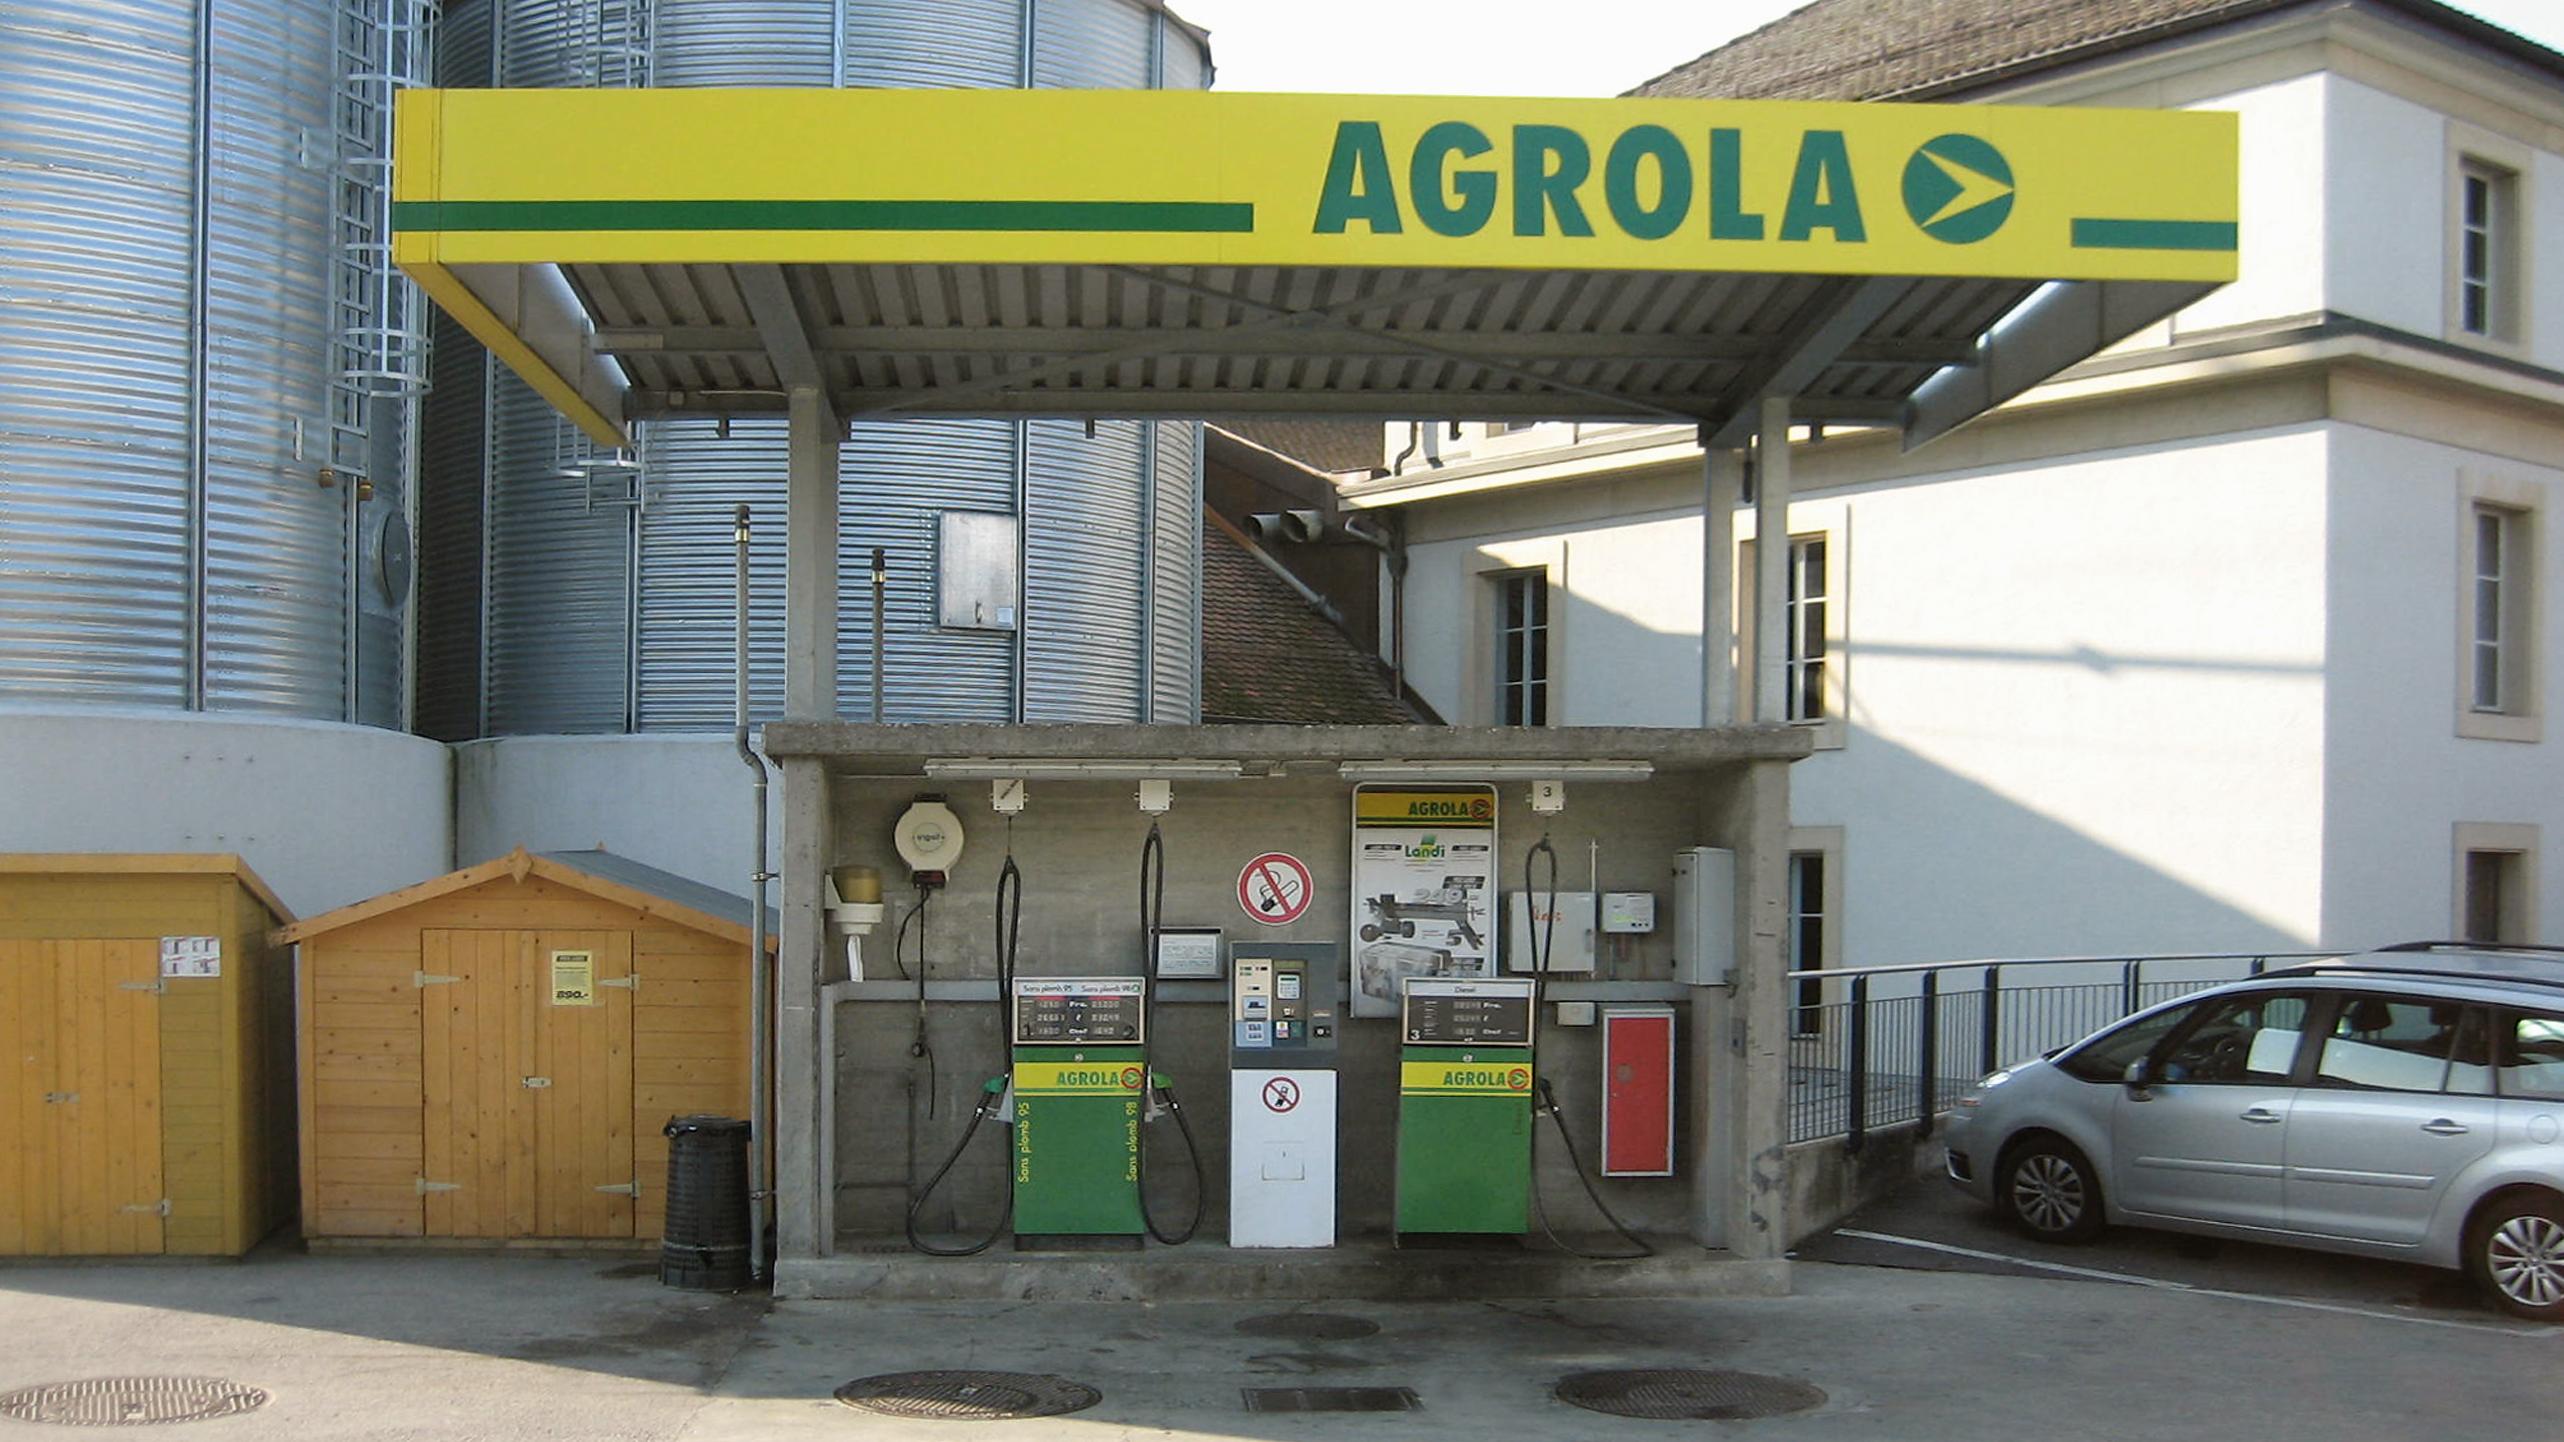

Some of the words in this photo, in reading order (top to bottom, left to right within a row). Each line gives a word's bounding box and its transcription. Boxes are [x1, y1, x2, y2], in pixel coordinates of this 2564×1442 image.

[1312, 121, 1867, 243] AGROLA
[1543, 786, 1552, 798] 3
[1408, 802, 1468, 816] AGROLA
[1405, 845, 1445, 858] Landi
[1410, 1029, 1420, 1041] 3
[1056, 1071, 1120, 1086] AGROLA
[1443, 1071, 1506, 1086] AGROLA
[1018, 1102, 1030, 1117] 95
[1125, 1101, 1137, 1116] 98
[1018, 1120, 1032, 1154] plomb
[1018, 1157, 1030, 1184] Sans
[1125, 1155, 1137, 1182] Sans
